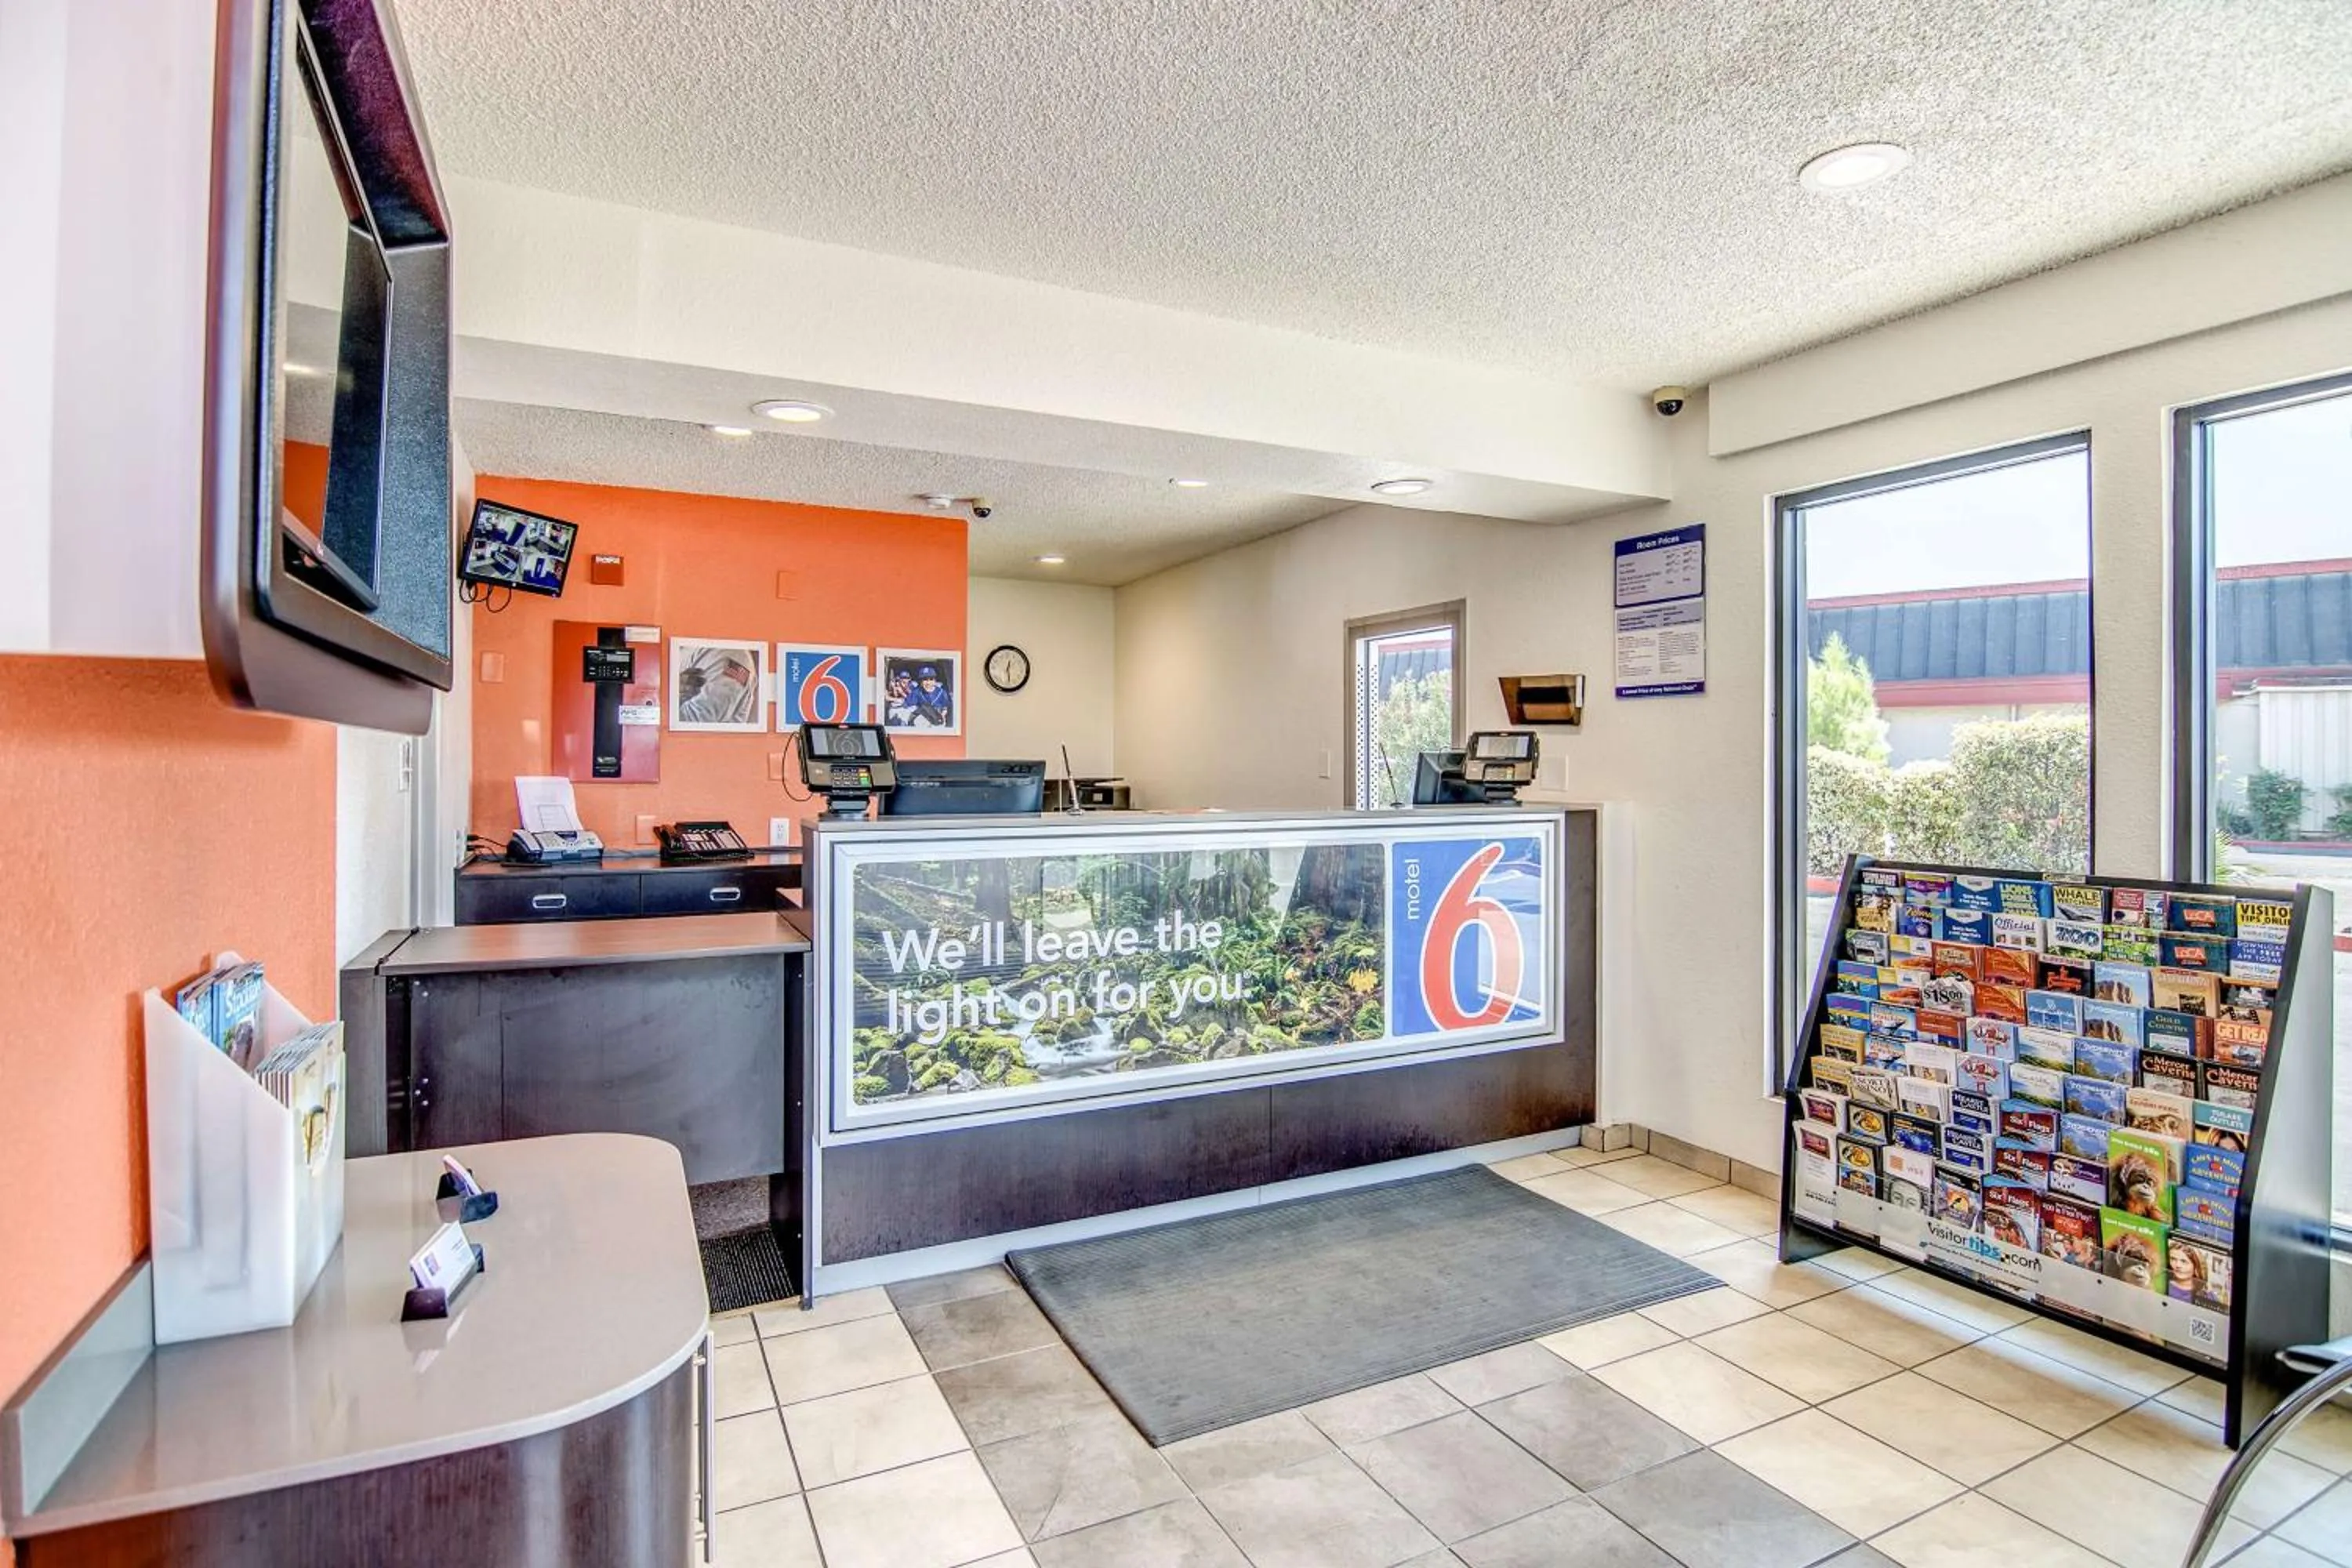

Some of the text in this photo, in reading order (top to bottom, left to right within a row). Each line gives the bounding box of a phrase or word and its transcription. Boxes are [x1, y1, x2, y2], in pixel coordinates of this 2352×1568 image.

[790, 657, 800, 683] motel
[798, 655, 851, 723] 6
[1405, 859, 1420, 920] motel
[2055, 887, 2100, 901] WHALE
[1994, 916, 2036, 931] Official
[882, 909, 1221, 973] We'll leave the
[1420, 841, 1524, 1032] 6
[888, 984, 1001, 1045] light
[1019, 988, 1076, 1020] on
[1092, 969, 1156, 1014] for
[2216, 1022, 2268, 1043] GET REA
[2142, 1060, 2196, 1080] Caverns
[2154, 1056, 2190, 1070] Mercer
[2206, 1071, 2259, 1091] Cavern
[2219, 1067, 2258, 1083] Mercer
[2009, 1115, 2050, 1134] Six Flags
[2003, 1151, 2044, 1171] Six Flags
[1989, 1191, 2031, 1208] Six Flags
